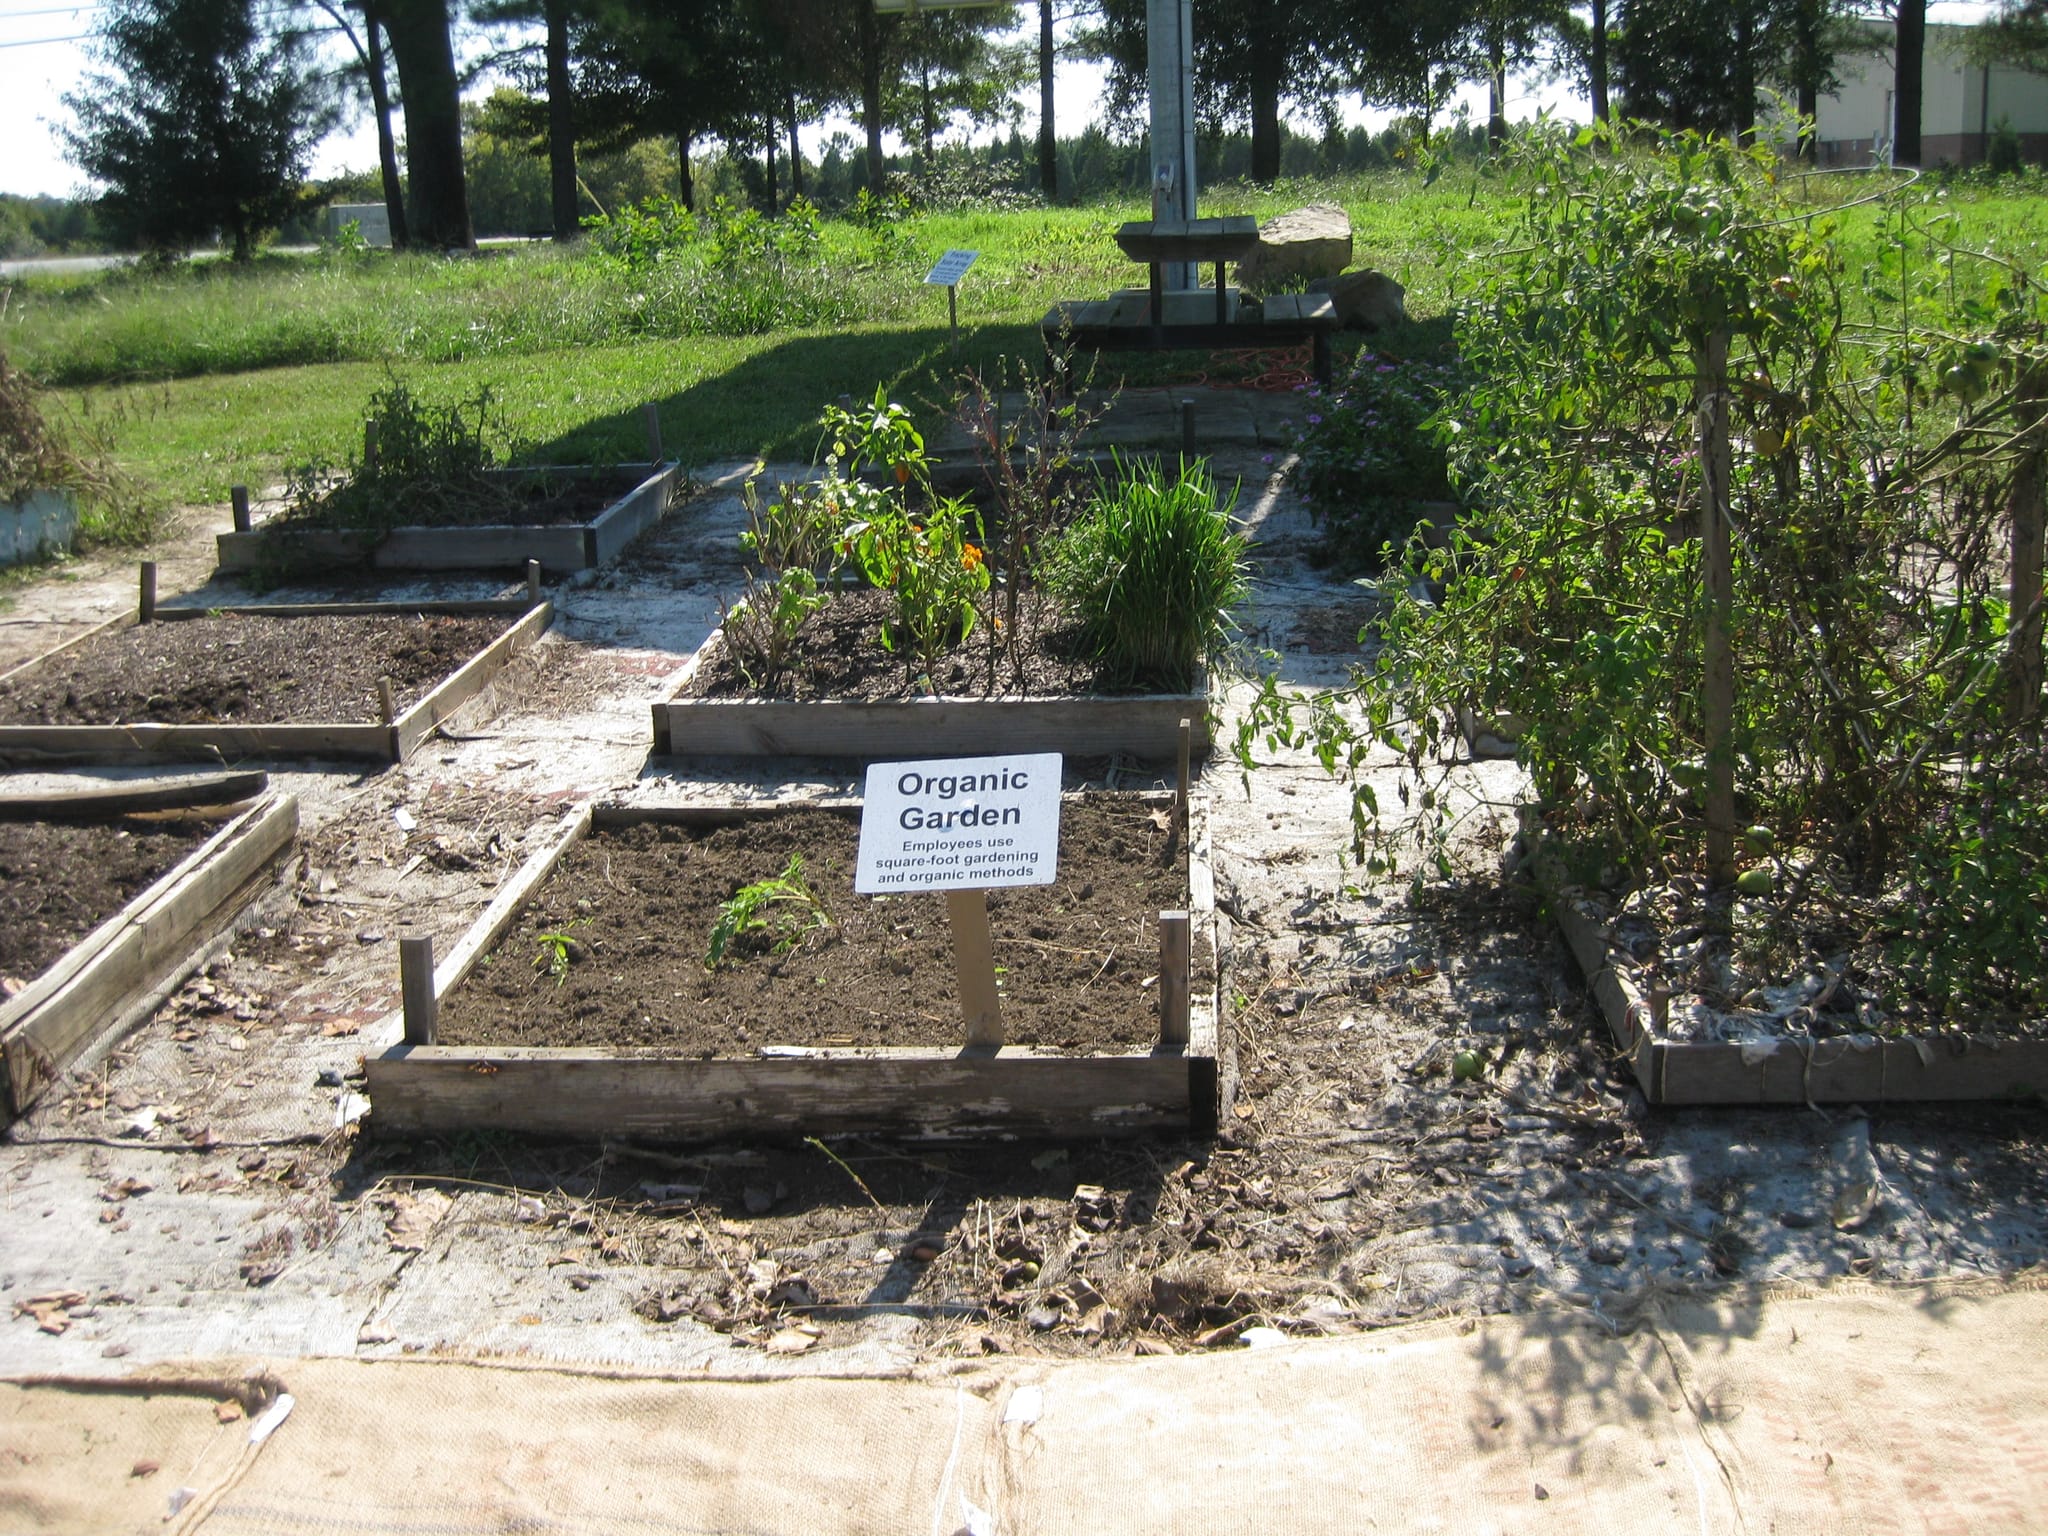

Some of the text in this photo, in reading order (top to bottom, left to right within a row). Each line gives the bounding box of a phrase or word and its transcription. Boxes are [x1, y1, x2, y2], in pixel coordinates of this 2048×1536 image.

[897, 767, 1029, 799] Organic
[899, 804, 1021, 830] Garden
[902, 837, 1014, 856] Employees use
[875, 851, 1039, 870] square-foot gardening
[877, 866, 1034, 884] and organic methods
